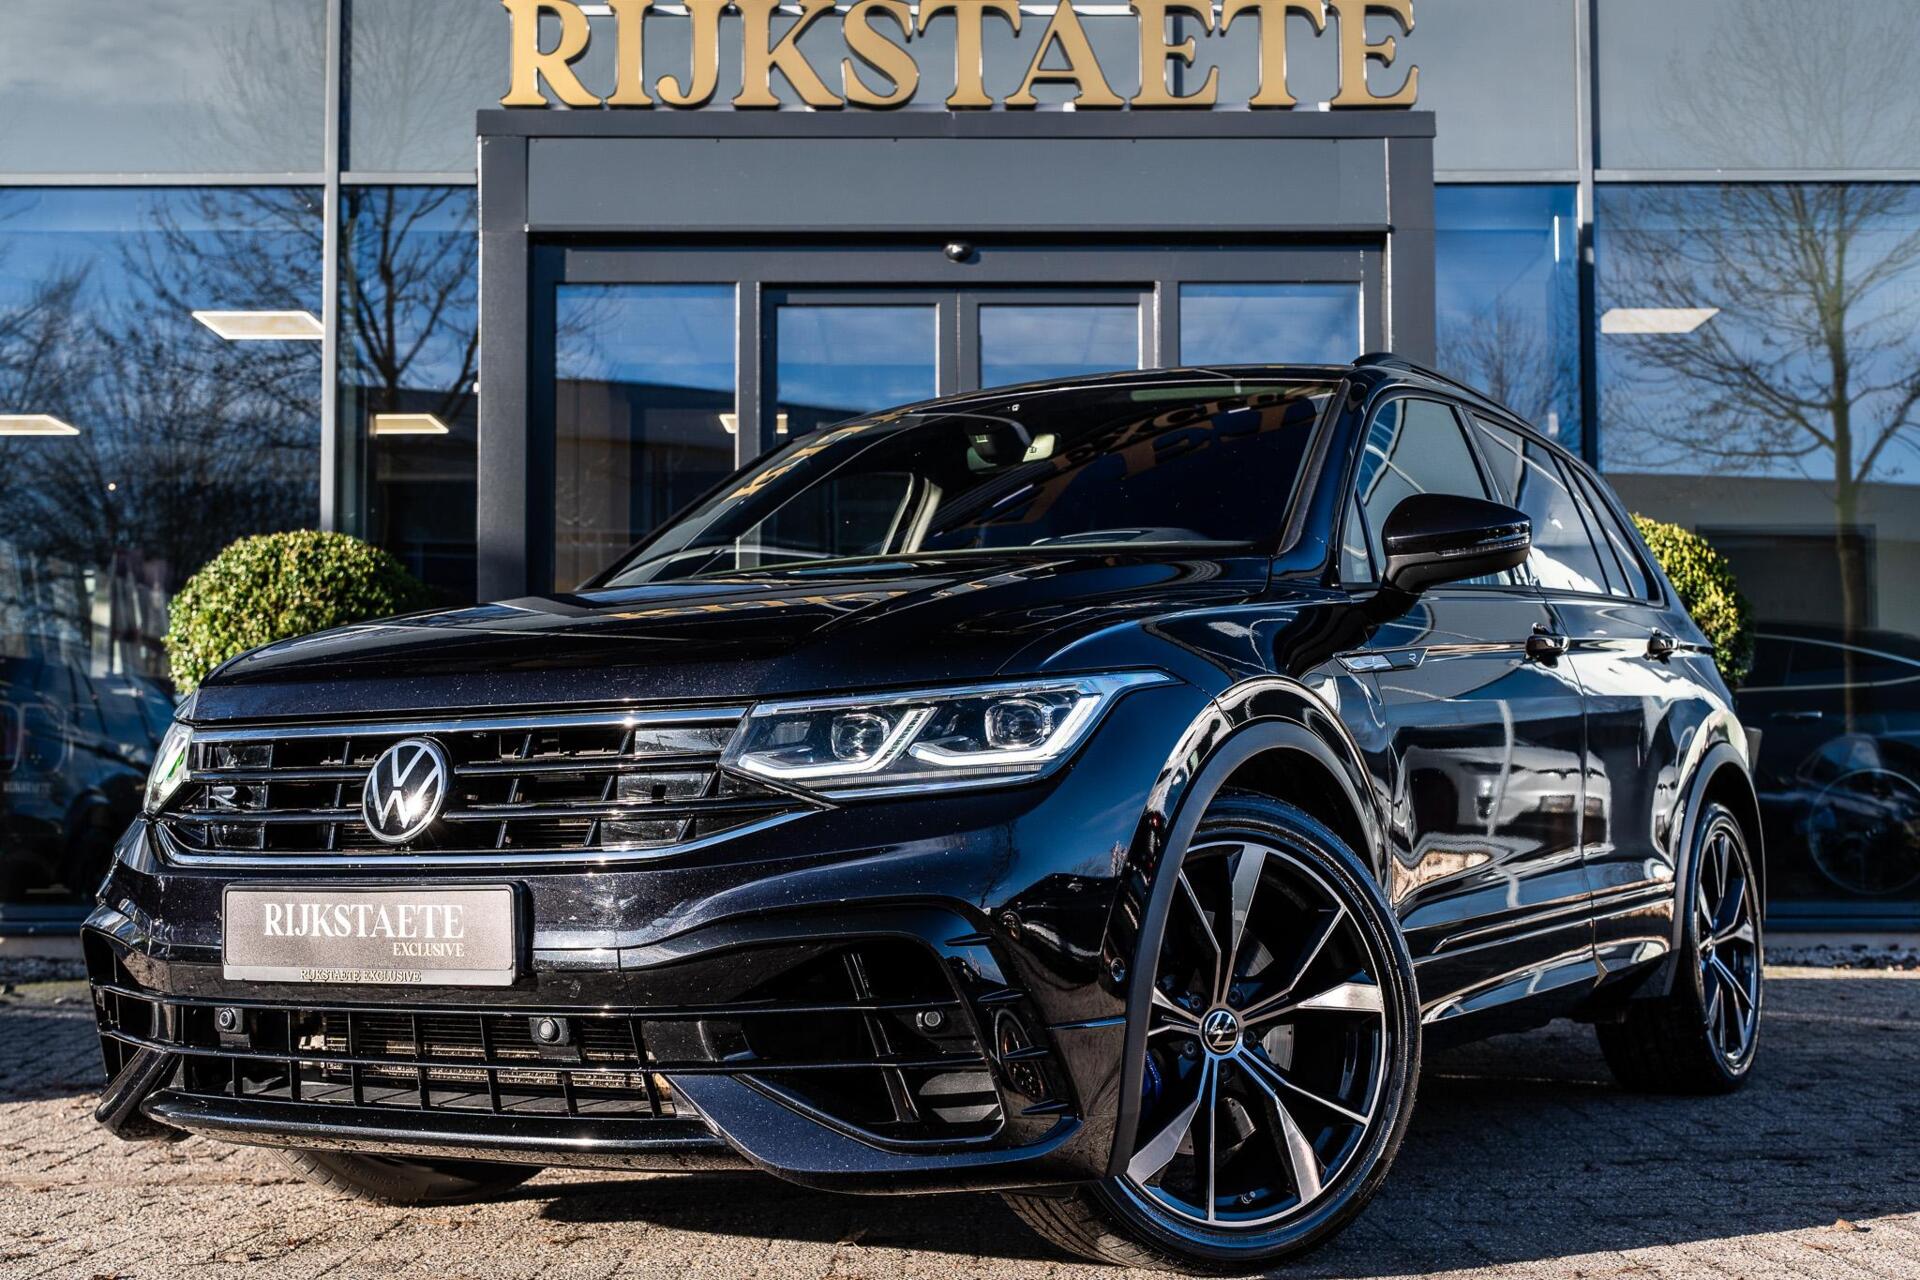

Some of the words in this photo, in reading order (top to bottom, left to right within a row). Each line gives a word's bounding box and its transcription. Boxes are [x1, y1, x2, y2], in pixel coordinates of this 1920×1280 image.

[499, 0, 1419, 109] RIJKSTAETE
[263, 903, 465, 939] RIJKSTAETE
[393, 942, 465, 957] EXCLUSIVE
[300, 969, 361, 982] RIJKSTAETE
[363, 970, 421, 982] EXCLUSIVE
